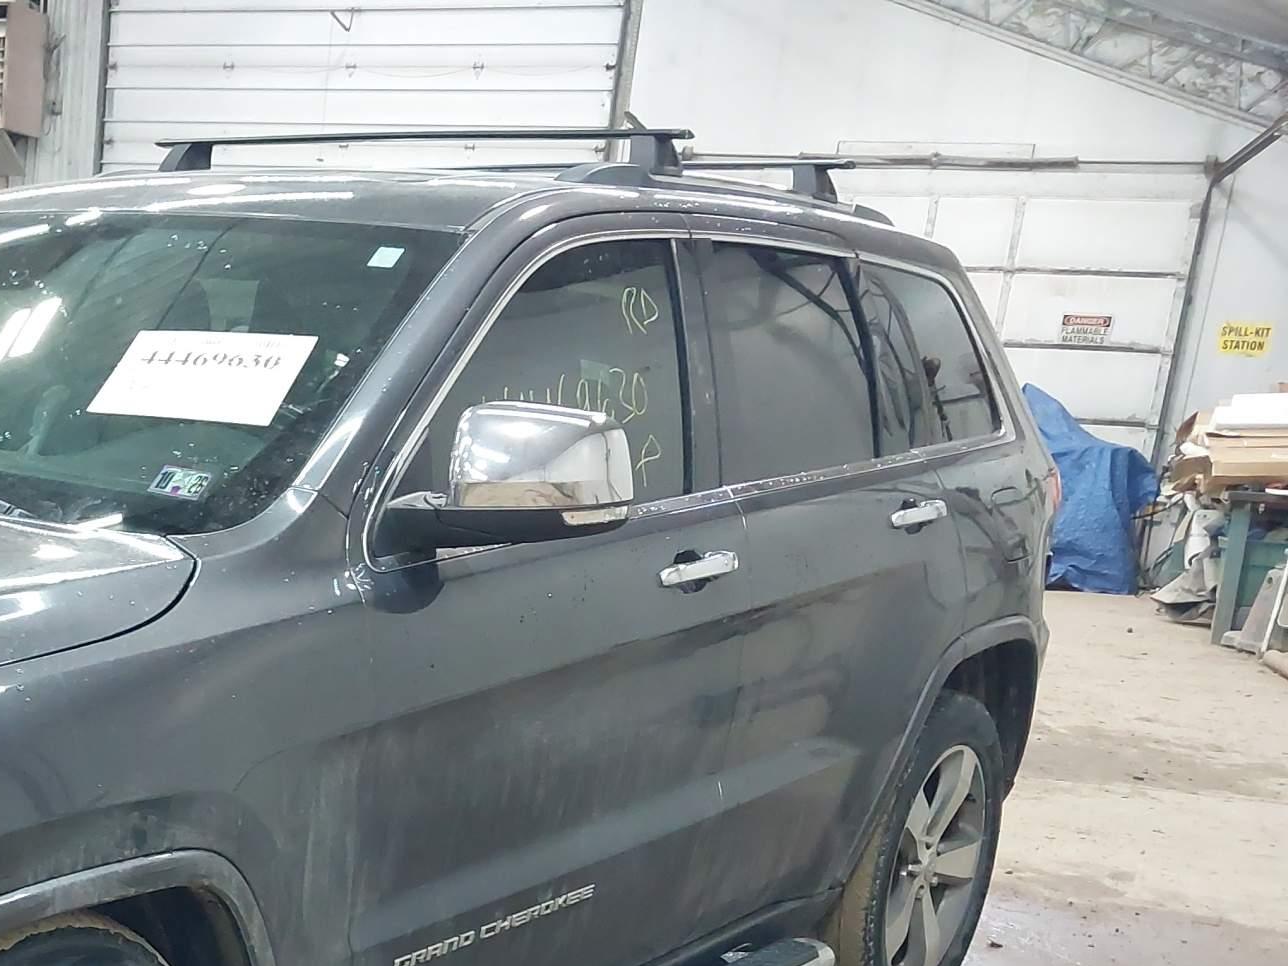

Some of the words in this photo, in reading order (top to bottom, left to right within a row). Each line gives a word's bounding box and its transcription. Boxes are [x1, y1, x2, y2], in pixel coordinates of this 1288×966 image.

[1221, 326, 1272, 337] SPILL-KIT
[1061, 335, 1105, 344] MATERIALS
[1222, 339, 1265, 351] STATION
[140, 350, 282, 370] 44469630
[479, 883, 596, 940] CHEROKEE
